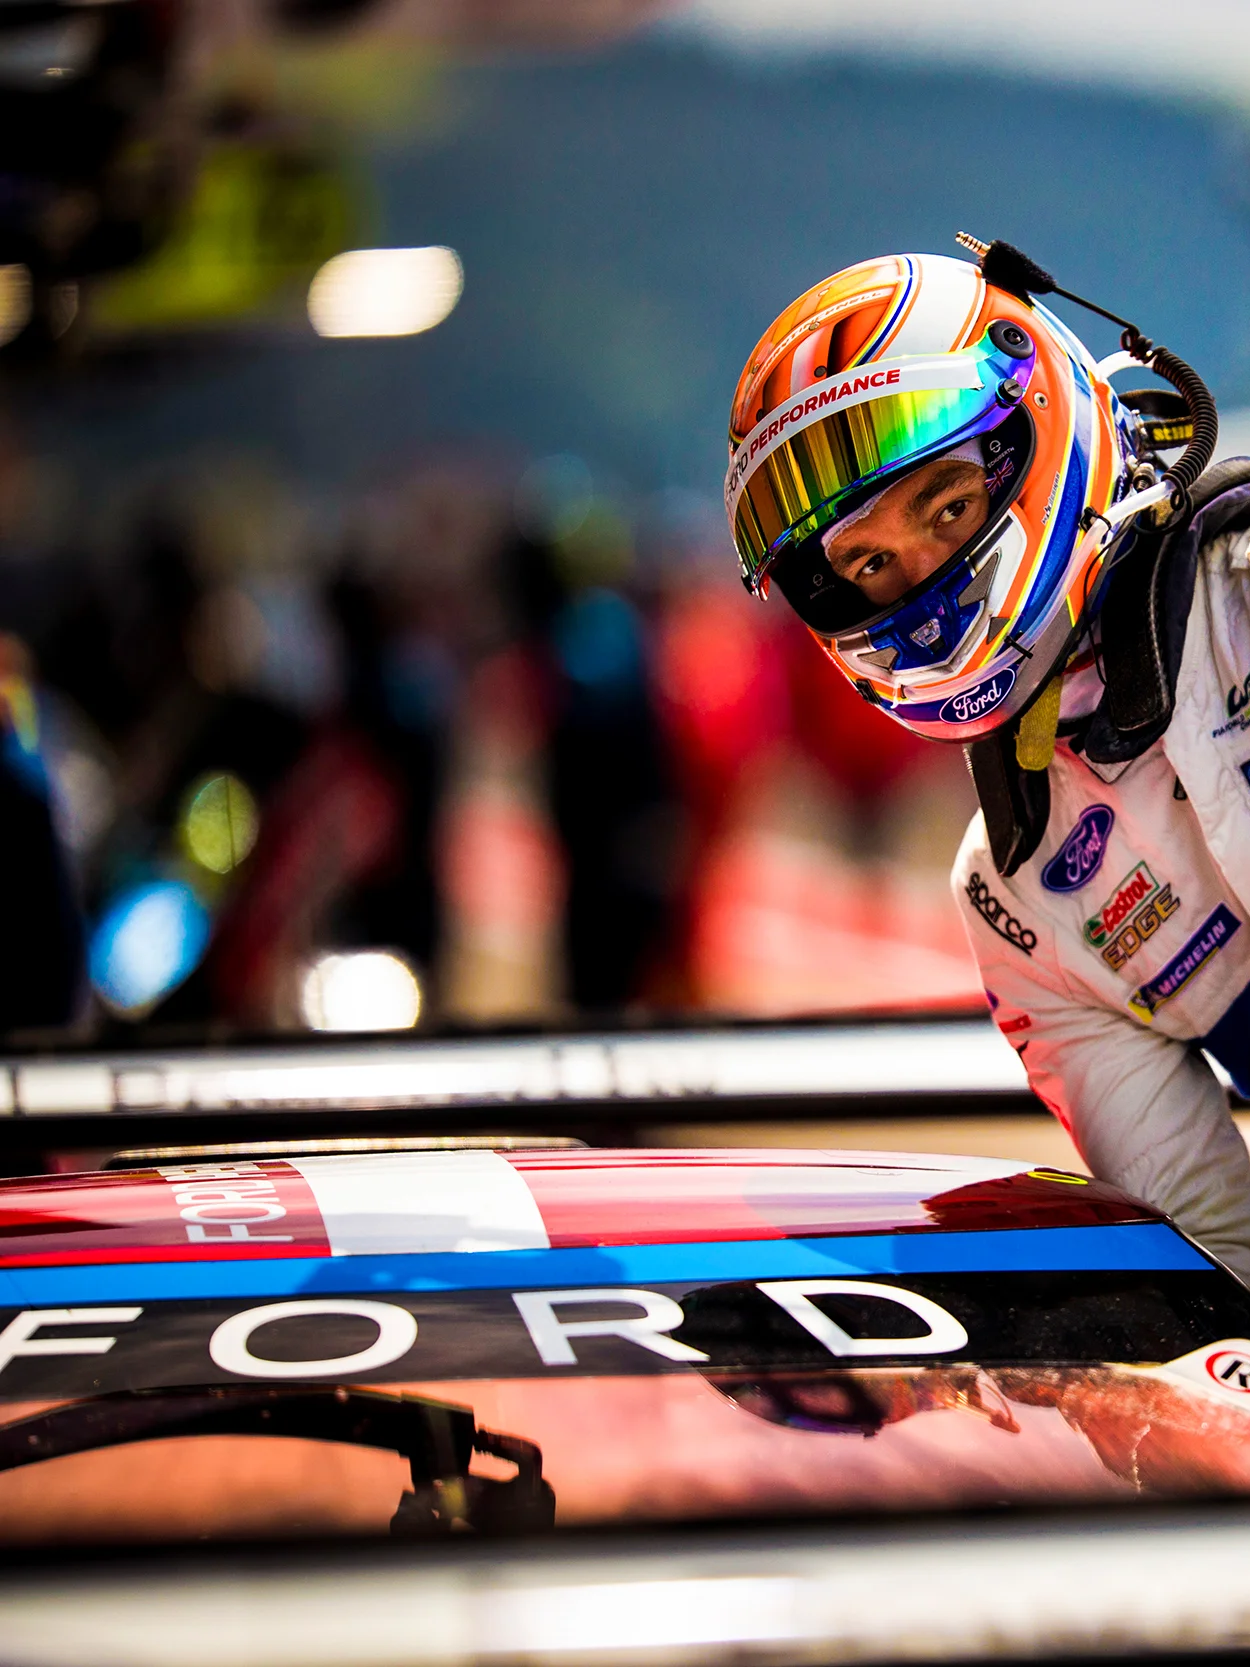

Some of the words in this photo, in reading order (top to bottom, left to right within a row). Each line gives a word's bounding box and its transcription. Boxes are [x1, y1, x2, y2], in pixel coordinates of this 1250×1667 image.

[750, 369, 900, 460] PERFORMANCE
[952, 679, 1002, 720] Ford
[1066, 819, 1104, 883] Ford
[965, 871, 1038, 954] sparco
[1095, 870, 1154, 936] Castrol
[1102, 882, 1181, 972] EDGE
[1157, 918, 1227, 995] MICHELIN
